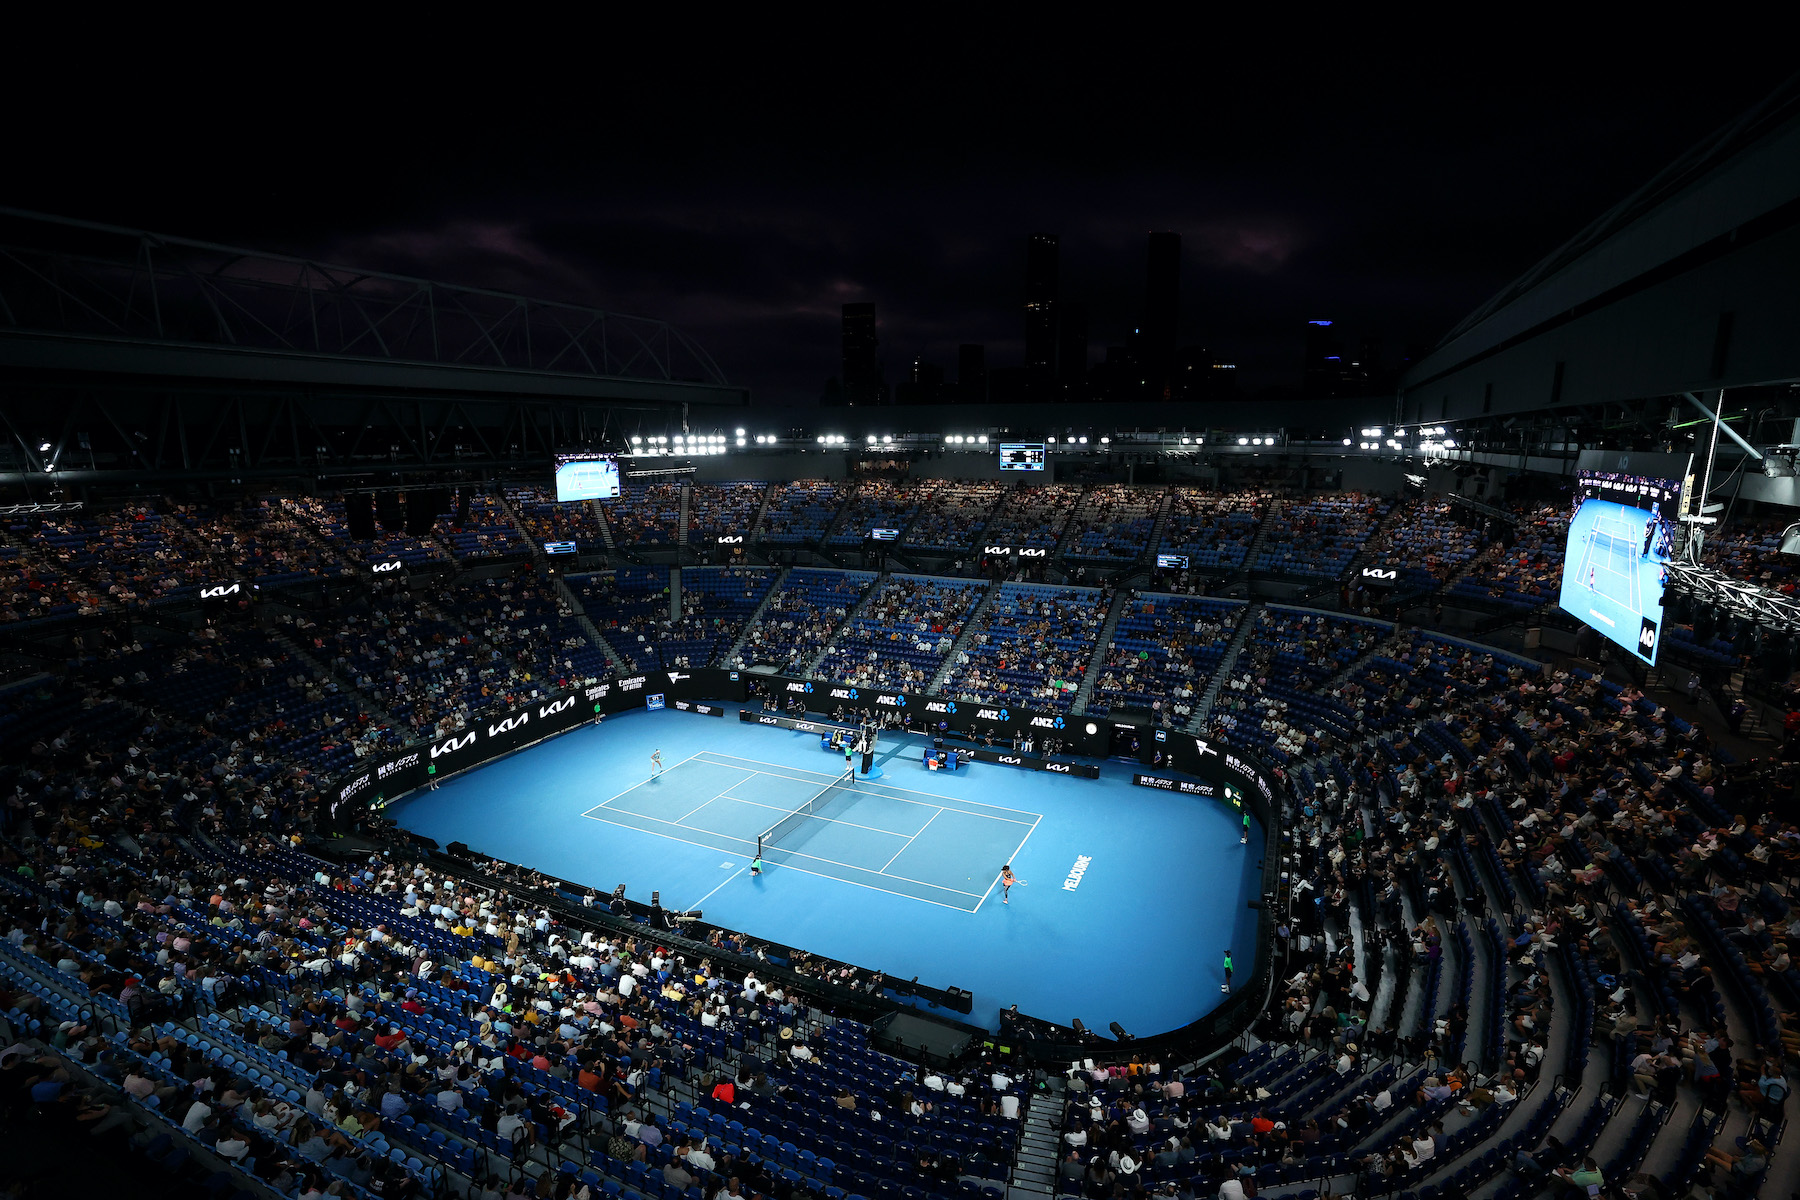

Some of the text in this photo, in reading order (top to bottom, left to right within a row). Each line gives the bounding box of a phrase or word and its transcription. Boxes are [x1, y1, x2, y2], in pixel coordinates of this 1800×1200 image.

[373, 561, 401, 572] KIA
[1363, 568, 1396, 579] KIA
[201, 584, 239, 598] KIA
[1639, 627, 1655, 647] AO
[618, 676, 646, 688] Emirates
[786, 682, 805, 693] ANZ
[585, 684, 610, 696] Emirates
[830, 688, 850, 699] ANZ
[539, 695, 575, 718] KIA
[876, 695, 897, 706] ANZ
[925, 702, 947, 713] ANZ
[976, 708, 999, 720] ANZ
[489, 713, 528, 737] KIA
[796, 722, 815, 730] KIA
[1030, 716, 1054, 729] ANZ
[430, 731, 476, 758] KIA
[999, 756, 1021, 764] KIA
[1046, 763, 1069, 772] KIA
[1061, 854, 1093, 892] MELBOURNE
